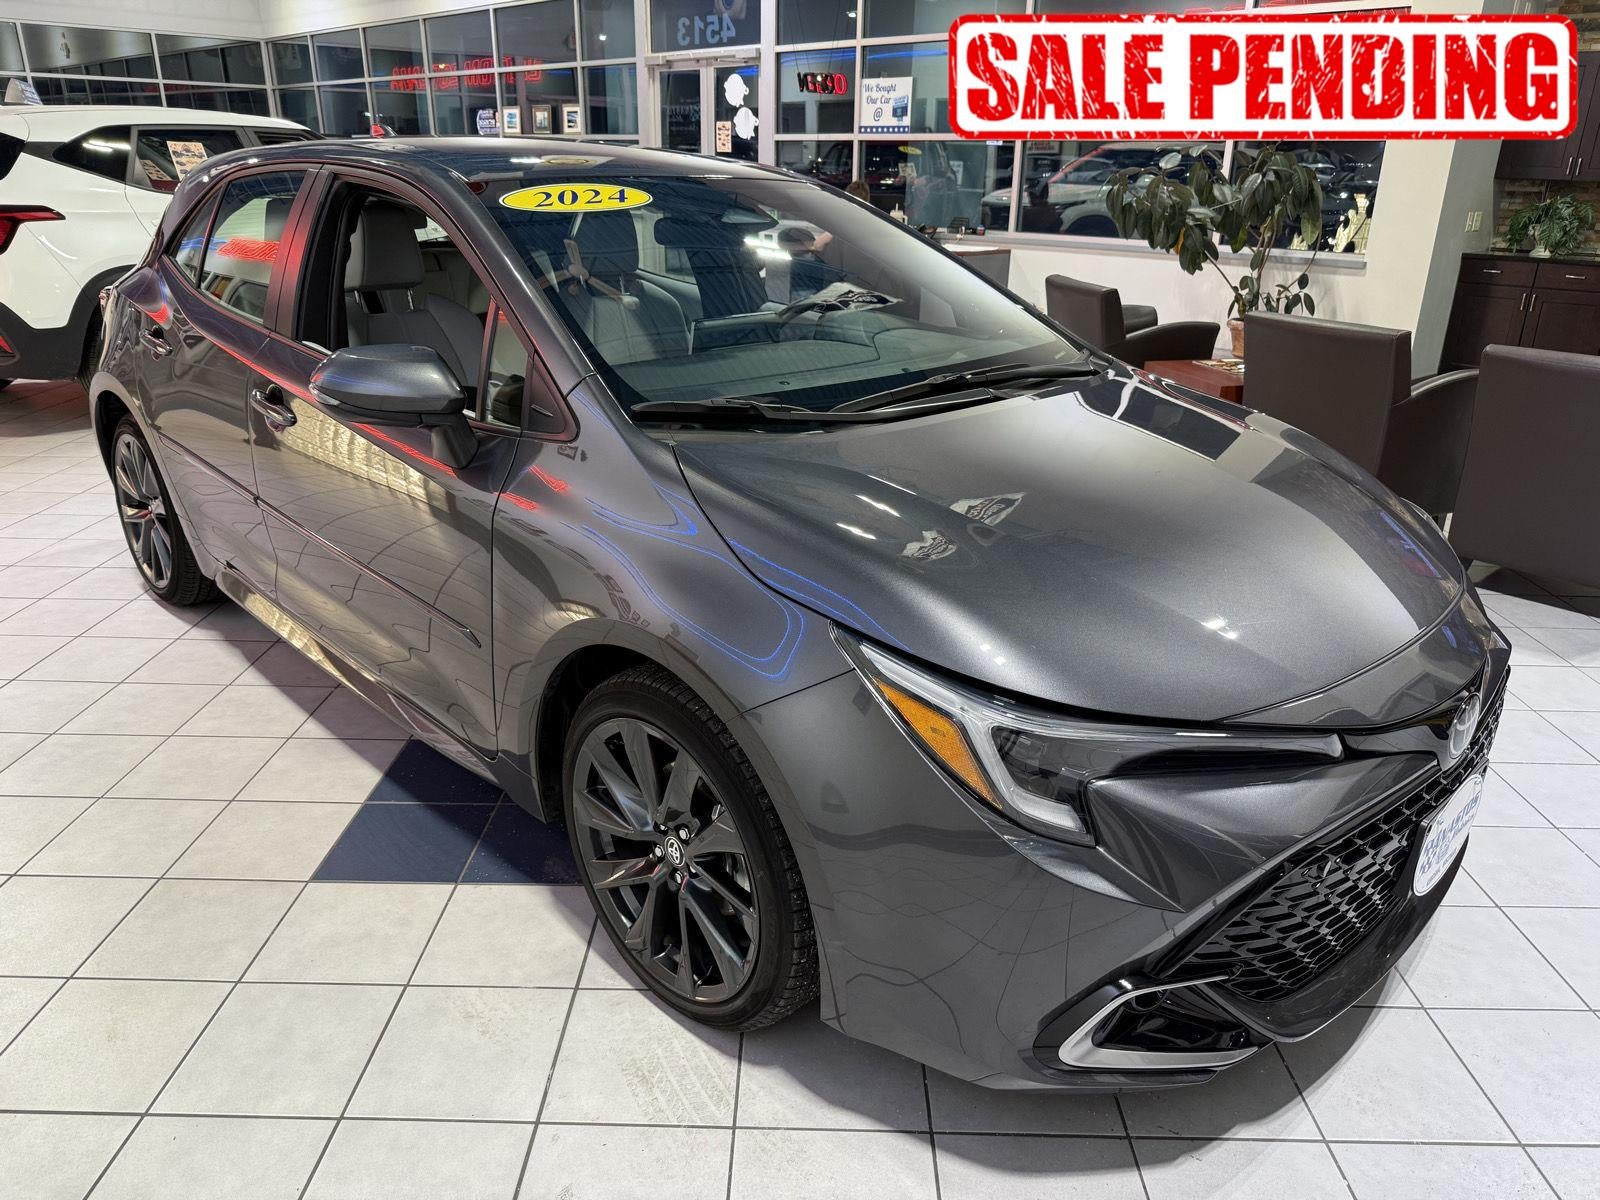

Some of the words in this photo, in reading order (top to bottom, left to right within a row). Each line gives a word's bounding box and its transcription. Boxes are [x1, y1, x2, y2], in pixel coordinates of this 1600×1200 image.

[863, 83, 874, 93] We
[876, 83, 897, 94] Bought
[866, 95, 879, 104] Our
[880, 95, 892, 104] Car
[873, 107, 883, 122] @
[533, 188, 628, 207] 2024
